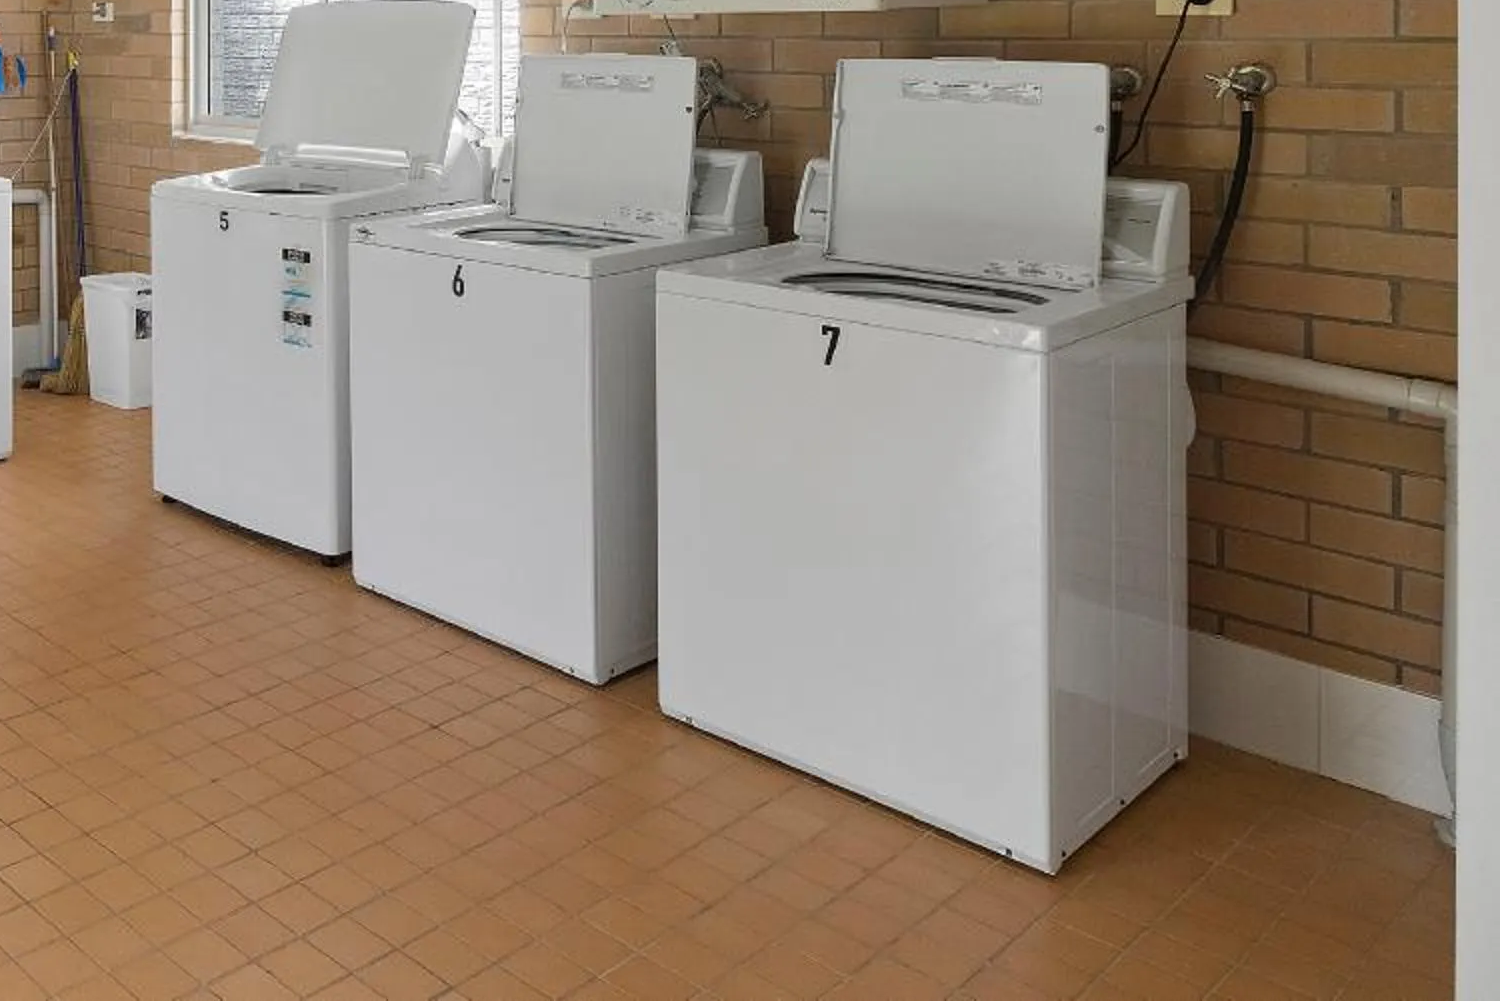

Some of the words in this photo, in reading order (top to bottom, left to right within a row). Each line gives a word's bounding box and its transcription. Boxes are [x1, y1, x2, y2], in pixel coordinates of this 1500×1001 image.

[219, 210, 230, 232] 5
[452, 264, 466, 298] 6
[821, 324, 841, 366] 7
